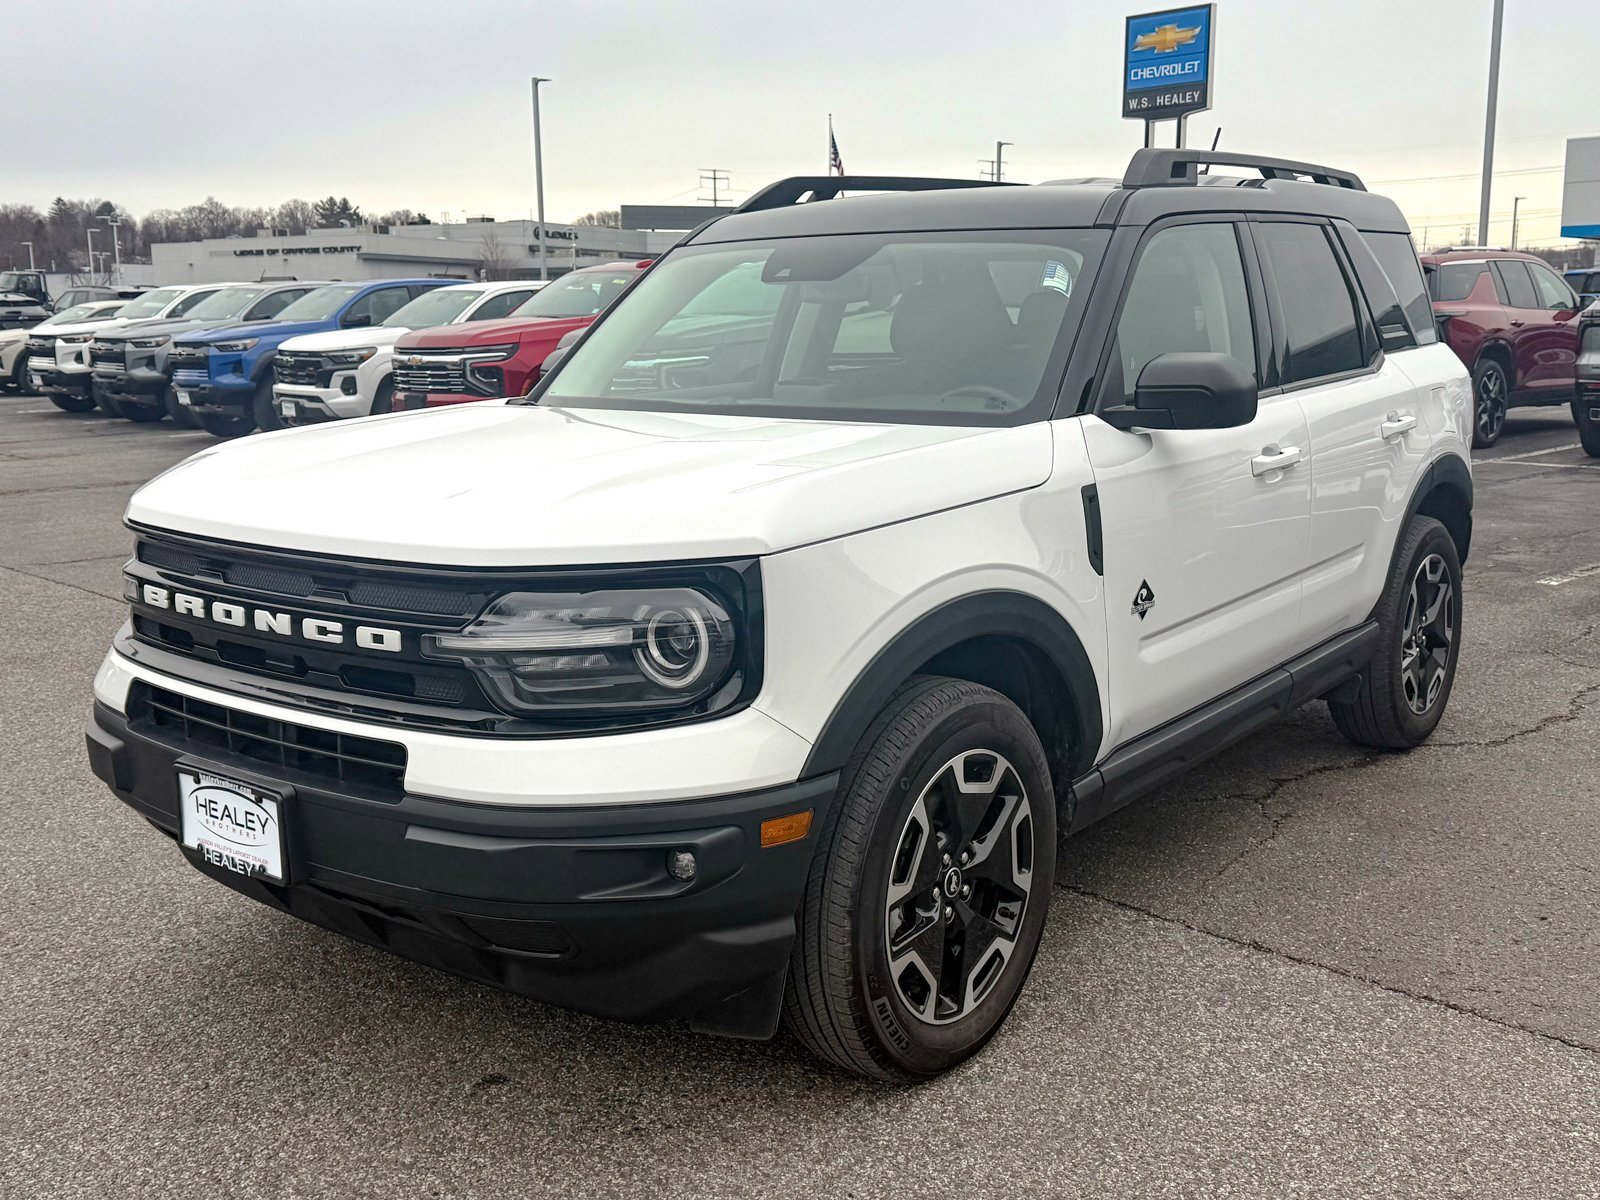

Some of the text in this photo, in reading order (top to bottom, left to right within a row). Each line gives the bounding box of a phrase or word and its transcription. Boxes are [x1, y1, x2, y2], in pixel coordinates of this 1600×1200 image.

[1130, 60, 1200, 80] CHEVROLET
[1128, 91, 1200, 110] W.S. HEALEY
[544, 230, 579, 240] LEXUS
[233, 245, 362, 257] LEXUS OF ORANGE COUNTY
[143, 584, 402, 652] BRONCO
[195, 795, 269, 835] HEALEY
[205, 818, 256, 840] BROTHERS
[204, 848, 254, 877] HEALEY
[233, 848, 251, 859] LARGEST
[251, 855, 269, 865] DEALER
[876, 1001, 914, 1056] CHELIN
